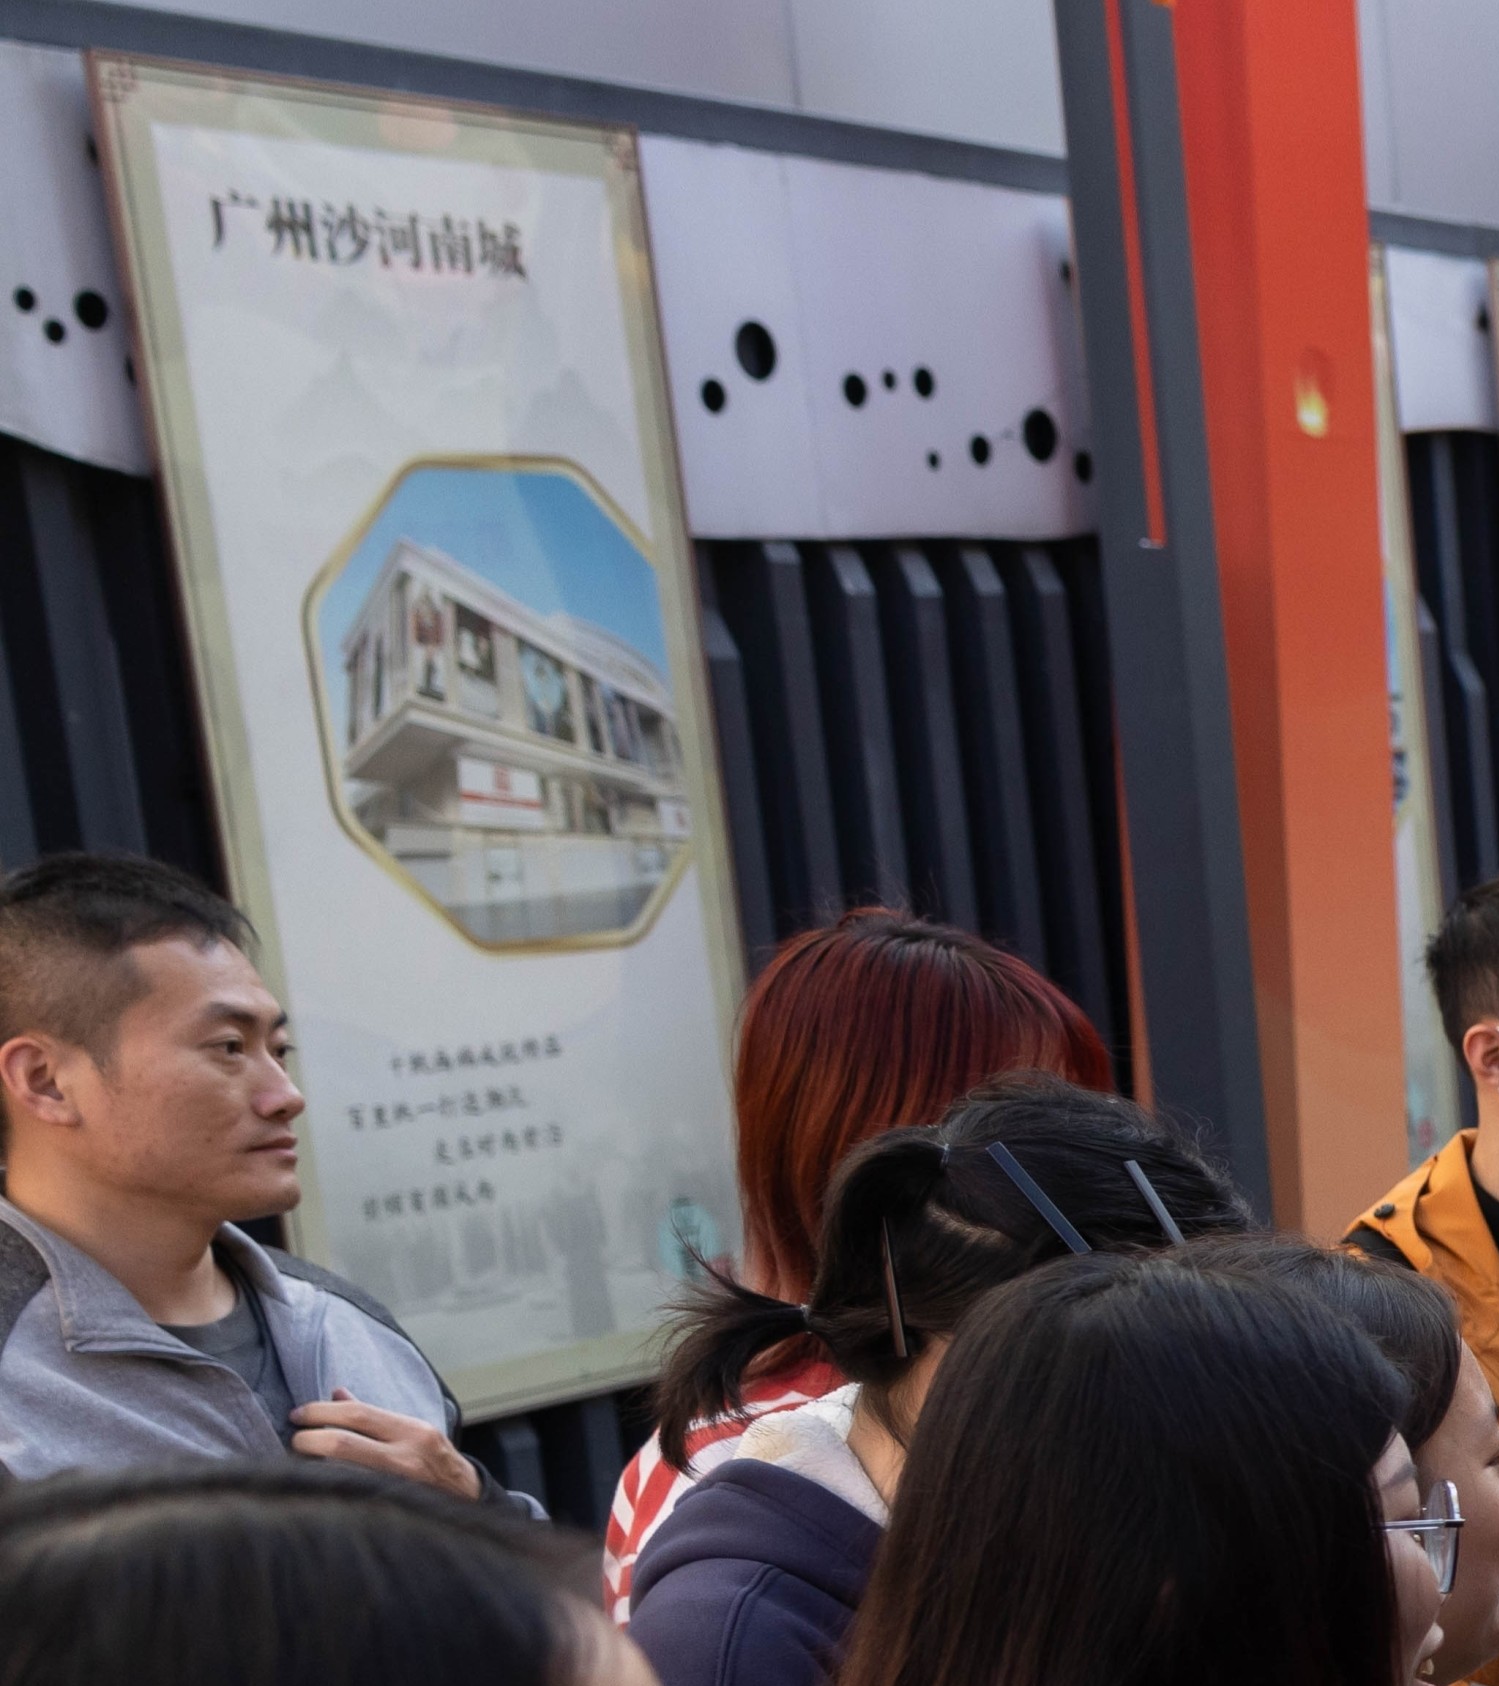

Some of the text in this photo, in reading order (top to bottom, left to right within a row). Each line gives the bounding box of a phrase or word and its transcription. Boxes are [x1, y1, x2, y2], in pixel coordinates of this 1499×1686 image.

[208, 187, 528, 281] 广州沙河南城
